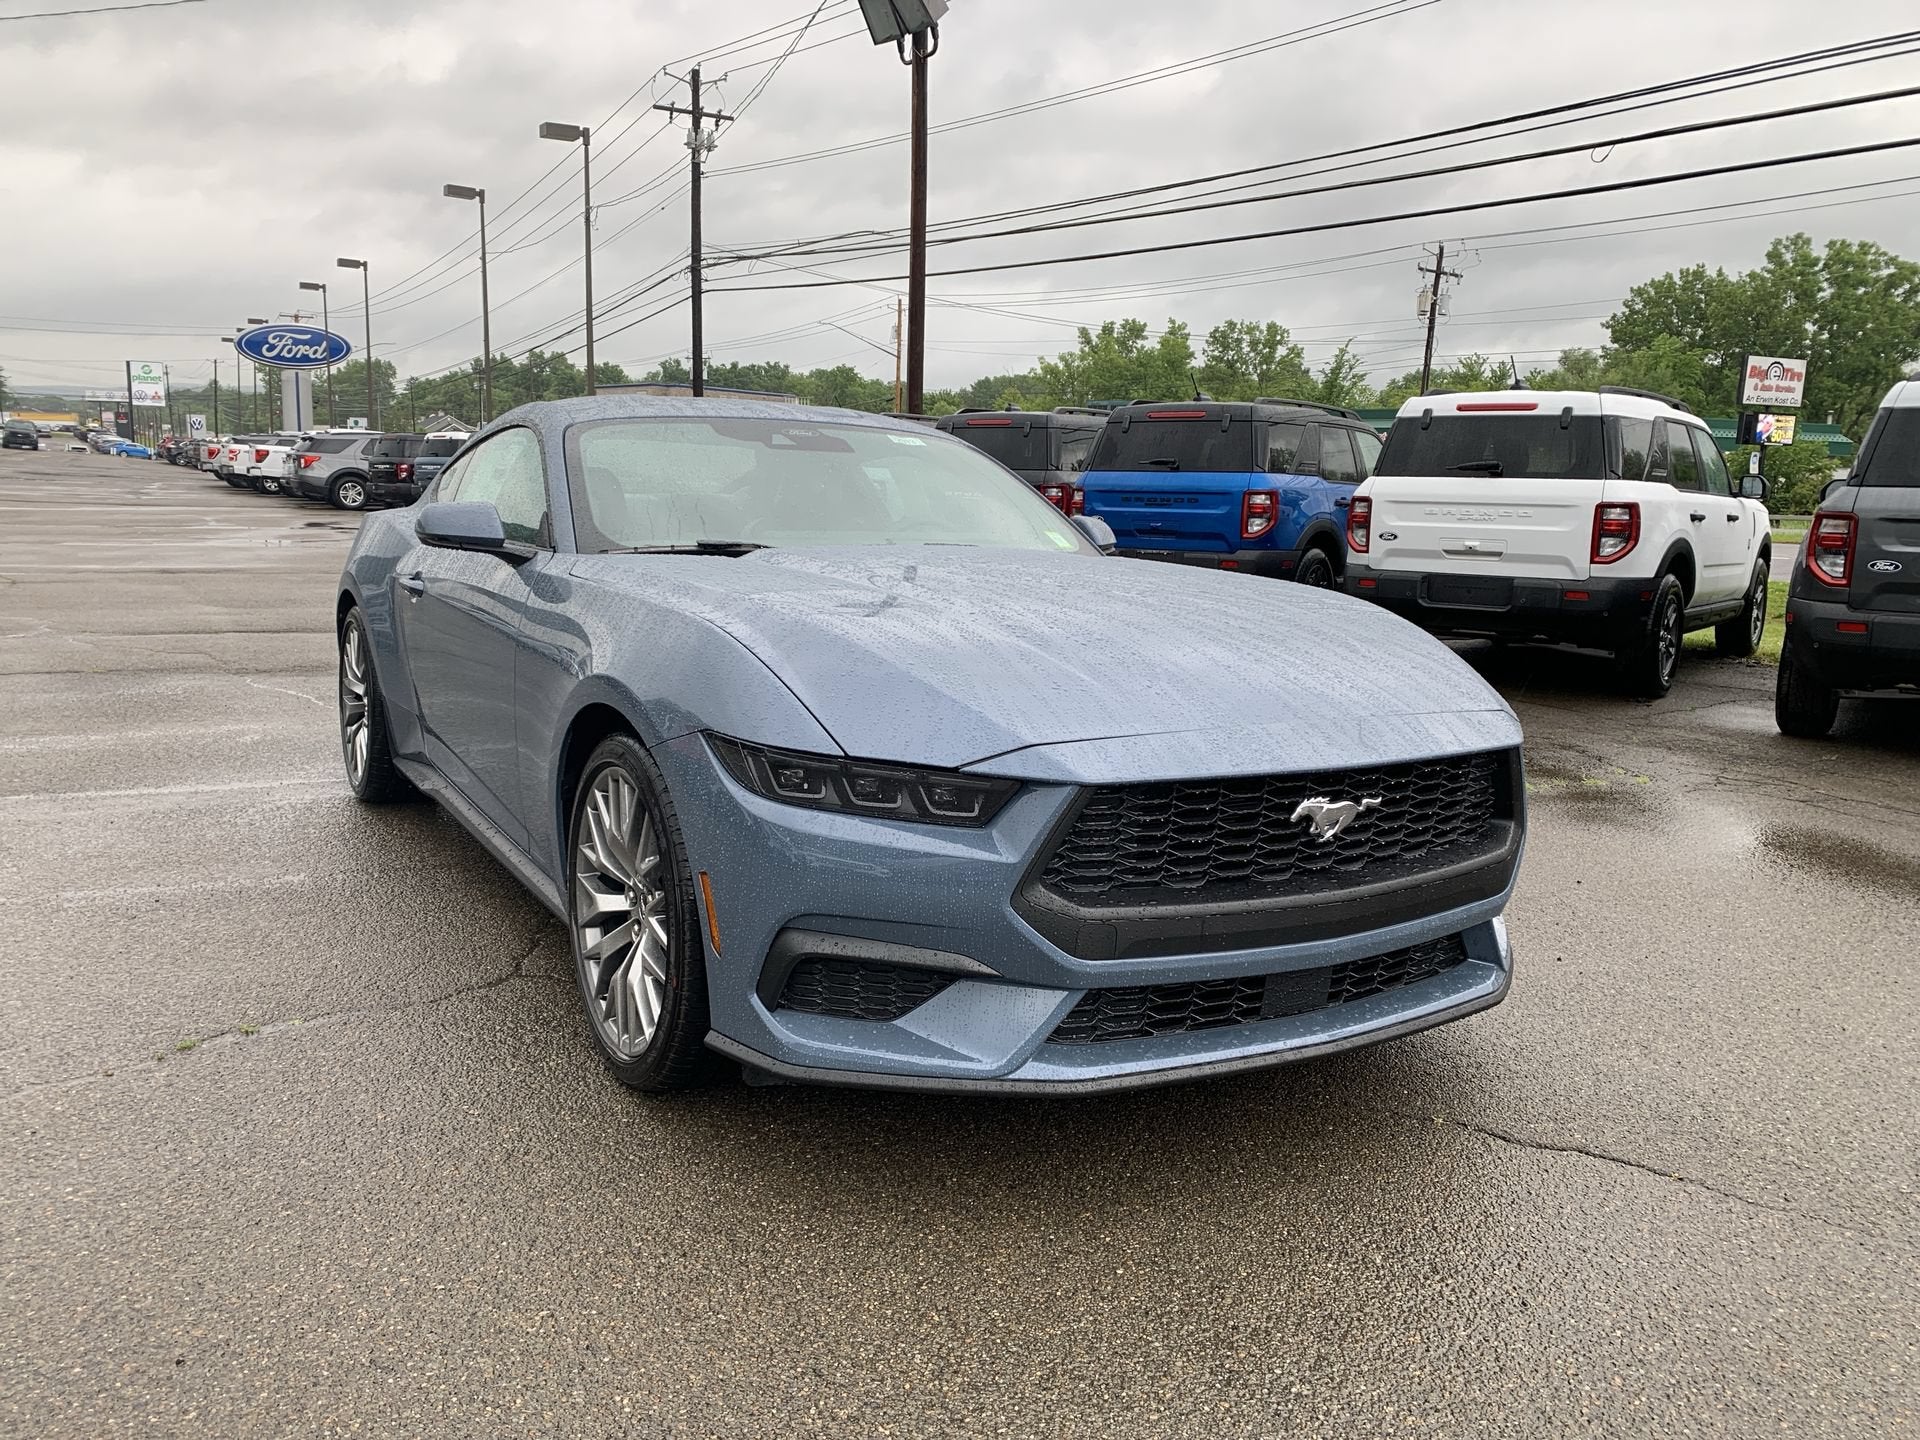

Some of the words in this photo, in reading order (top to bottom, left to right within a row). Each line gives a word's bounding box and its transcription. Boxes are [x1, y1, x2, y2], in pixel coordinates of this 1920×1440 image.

[262, 332, 327, 359] Ford
[132, 374, 162, 382] planet
[1748, 365, 1767, 382] Big
[1783, 367, 1804, 382] Tire
[1755, 395, 1774, 403] Erwin
[1774, 397, 1789, 405] Kost
[1424, 508, 1533, 517] BRONCO
